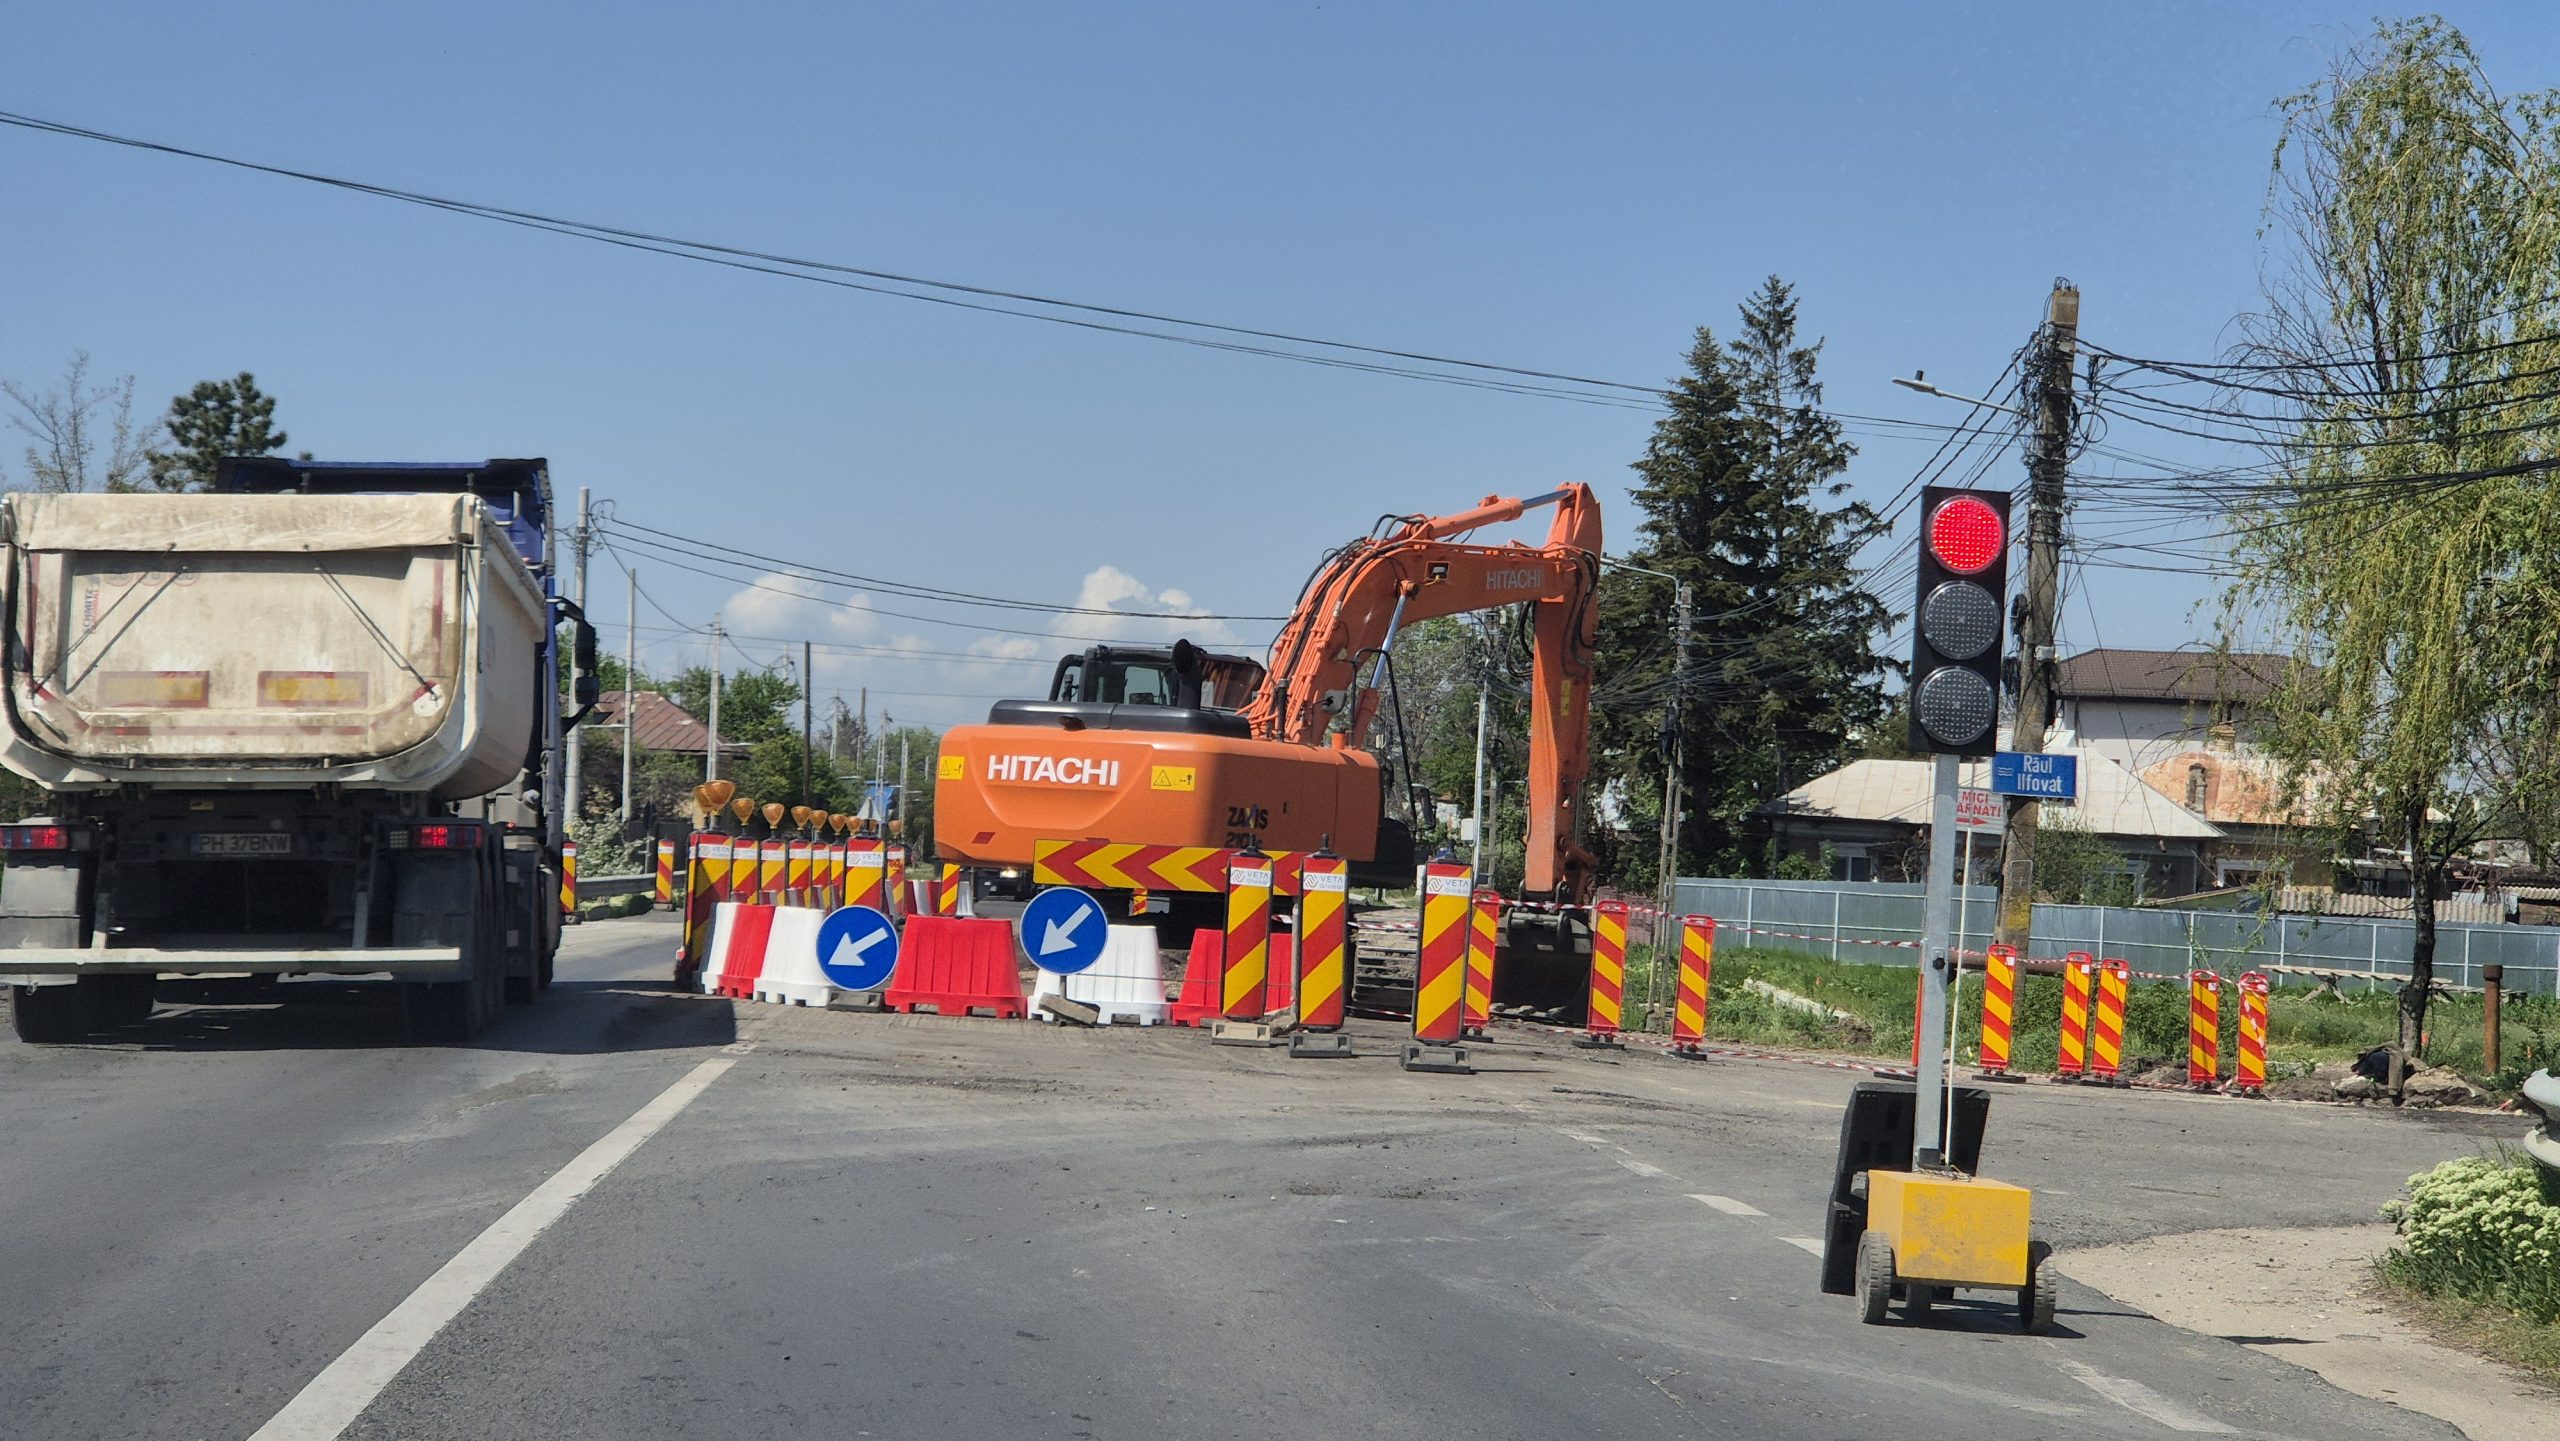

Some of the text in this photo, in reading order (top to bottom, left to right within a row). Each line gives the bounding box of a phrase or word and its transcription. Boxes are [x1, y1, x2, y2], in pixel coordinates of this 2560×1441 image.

[1486, 569, 1541, 590] HITACHI
[987, 754, 1119, 786] HITACHI
[1962, 791, 1989, 804] MICI
[1956, 803, 2001, 817] ARNATI
[200, 835, 223, 851] PH
[1247, 871, 1269, 879] VETA
[1320, 875, 1343, 883] VETA
[1445, 879, 1469, 887] VETA
